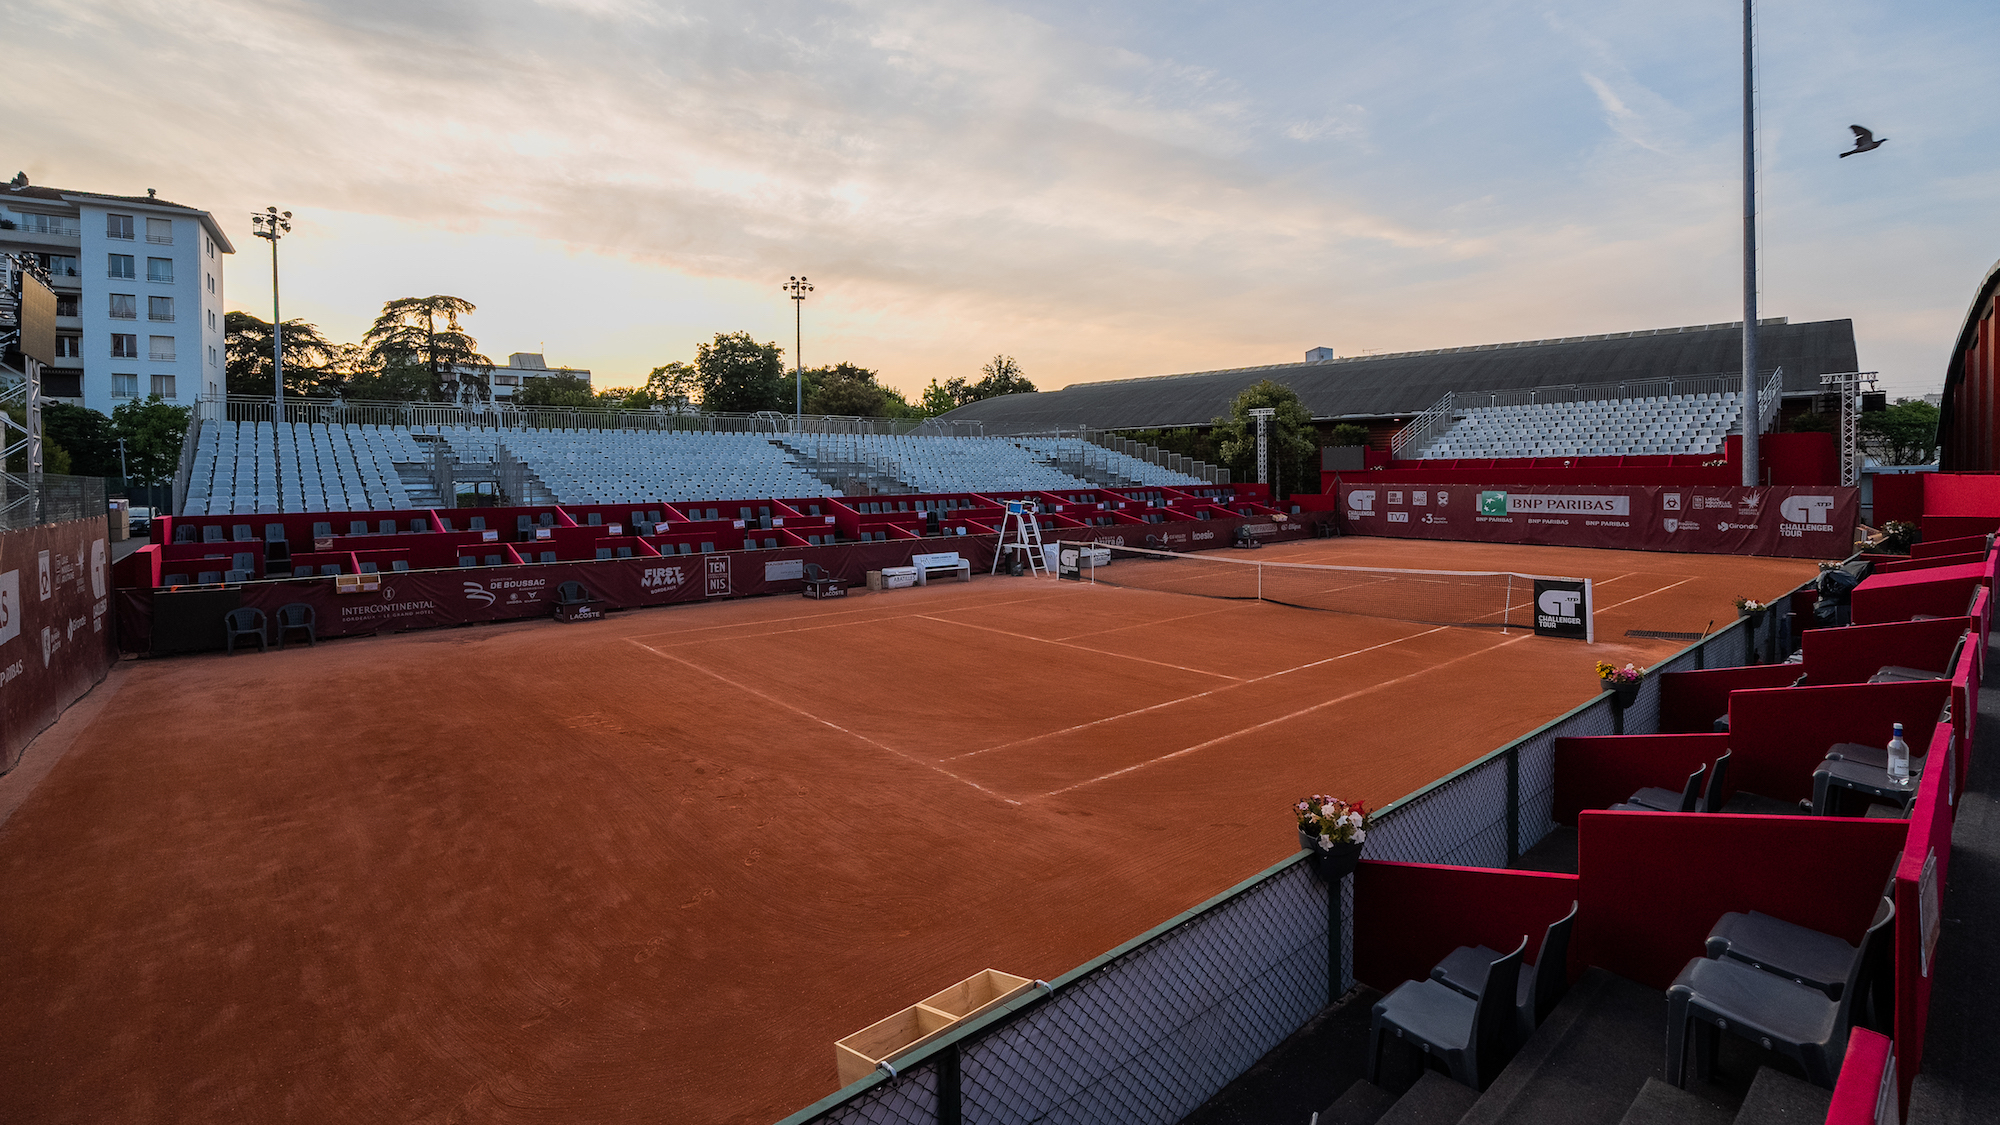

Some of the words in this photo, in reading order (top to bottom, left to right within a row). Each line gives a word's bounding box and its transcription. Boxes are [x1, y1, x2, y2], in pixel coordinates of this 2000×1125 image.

[1513, 499, 1543, 509] BNP
[1547, 499, 1614, 511] PARIBAS
[1426, 513, 1433, 524] 3
[1780, 523, 1834, 532] CHALLENGER
[1192, 530, 1214, 540] koesio
[644, 566, 682, 578] FIRST
[708, 561, 726, 573] TEN
[490, 581, 502, 590] DE
[503, 578, 546, 589] BOUSSAC
[641, 573, 685, 588] NAME
[709, 578, 726, 590] NIS
[650, 585, 677, 595] BORDEAUX
[569, 611, 600, 620] LACOSTE
[1538, 615, 1581, 625] CHALLENGER
[1538, 621, 1557, 629] TOUR
